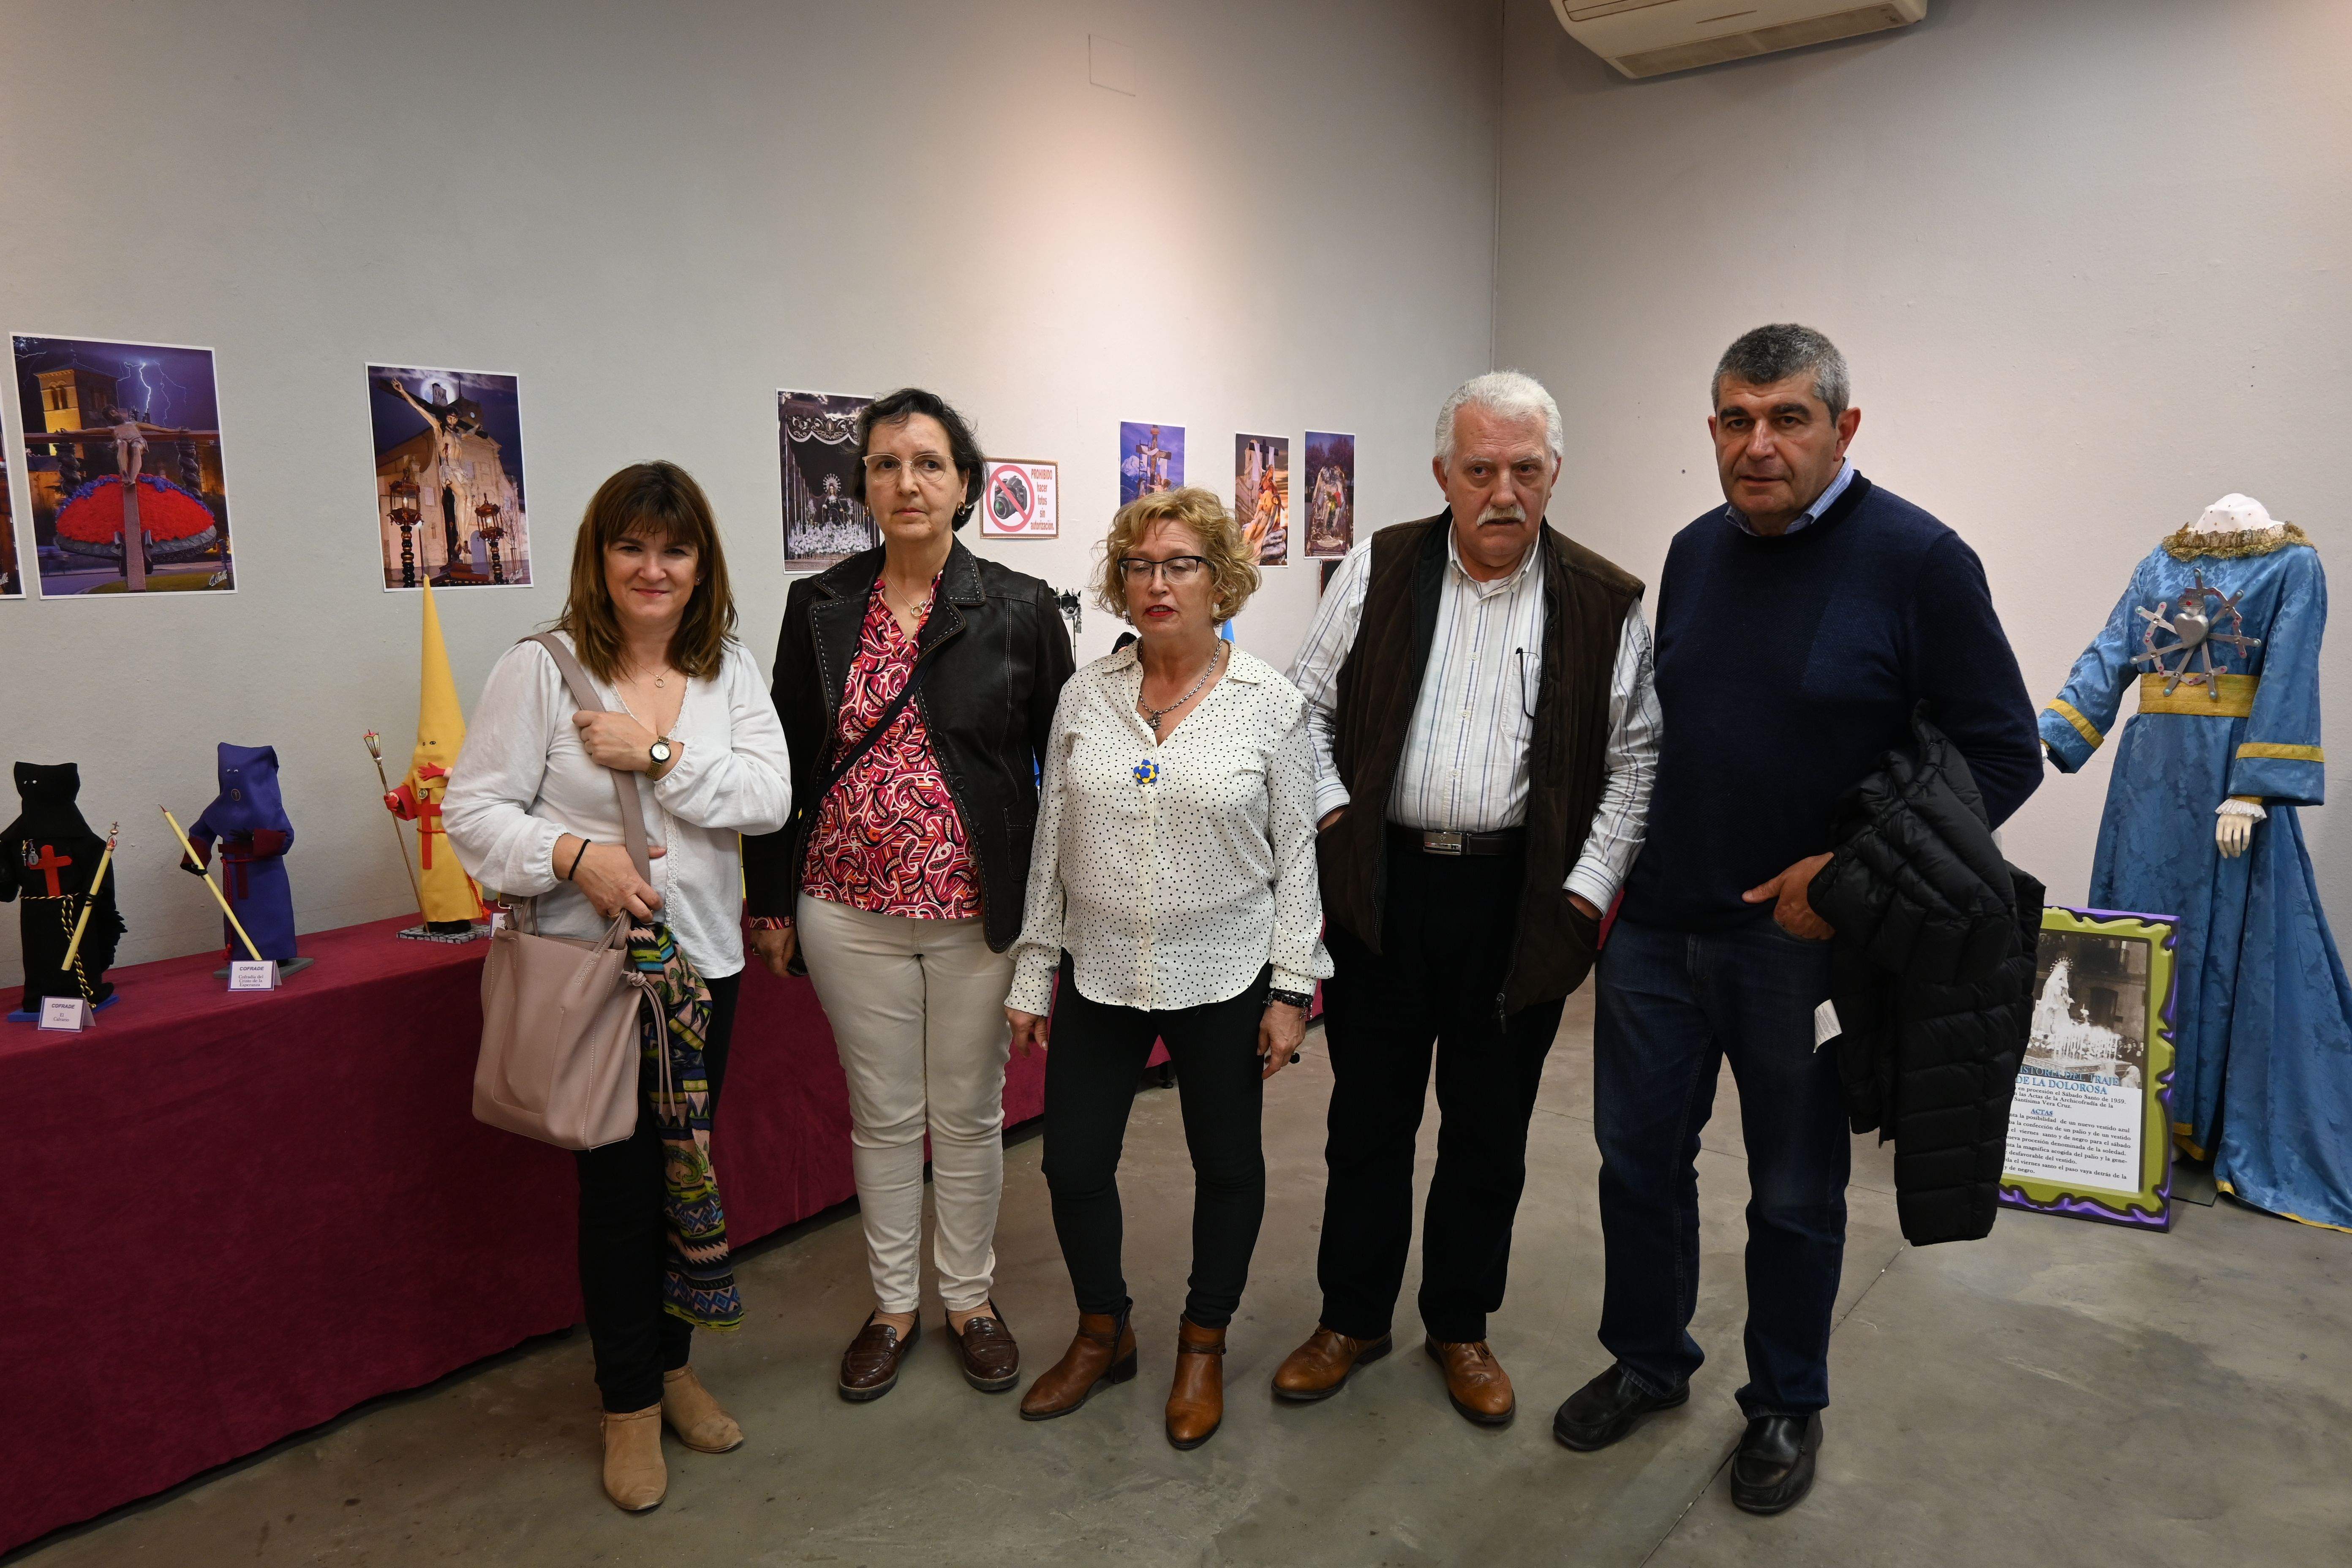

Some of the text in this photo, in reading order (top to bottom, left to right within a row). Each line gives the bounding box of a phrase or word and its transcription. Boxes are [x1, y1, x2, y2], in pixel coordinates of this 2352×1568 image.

[1031, 468, 1052, 480] PROHIBIDO
[1037, 482, 1047, 492] hacer
[1037, 494, 1047, 505] fotos
[1030, 520, 1054, 530] autorización.
[2020, 1066, 2120, 1086] ISTORIA DEL TRAJE
[2015, 1075, 2107, 1094] DE LA DOLOROSA
[2060, 1097, 2098, 1106] Archicofradía
[2031, 1108, 2053, 1117] ACTAS
[2051, 1141, 2085, 1150] denominada
[2009, 1150, 2044, 1159] desfavorable
